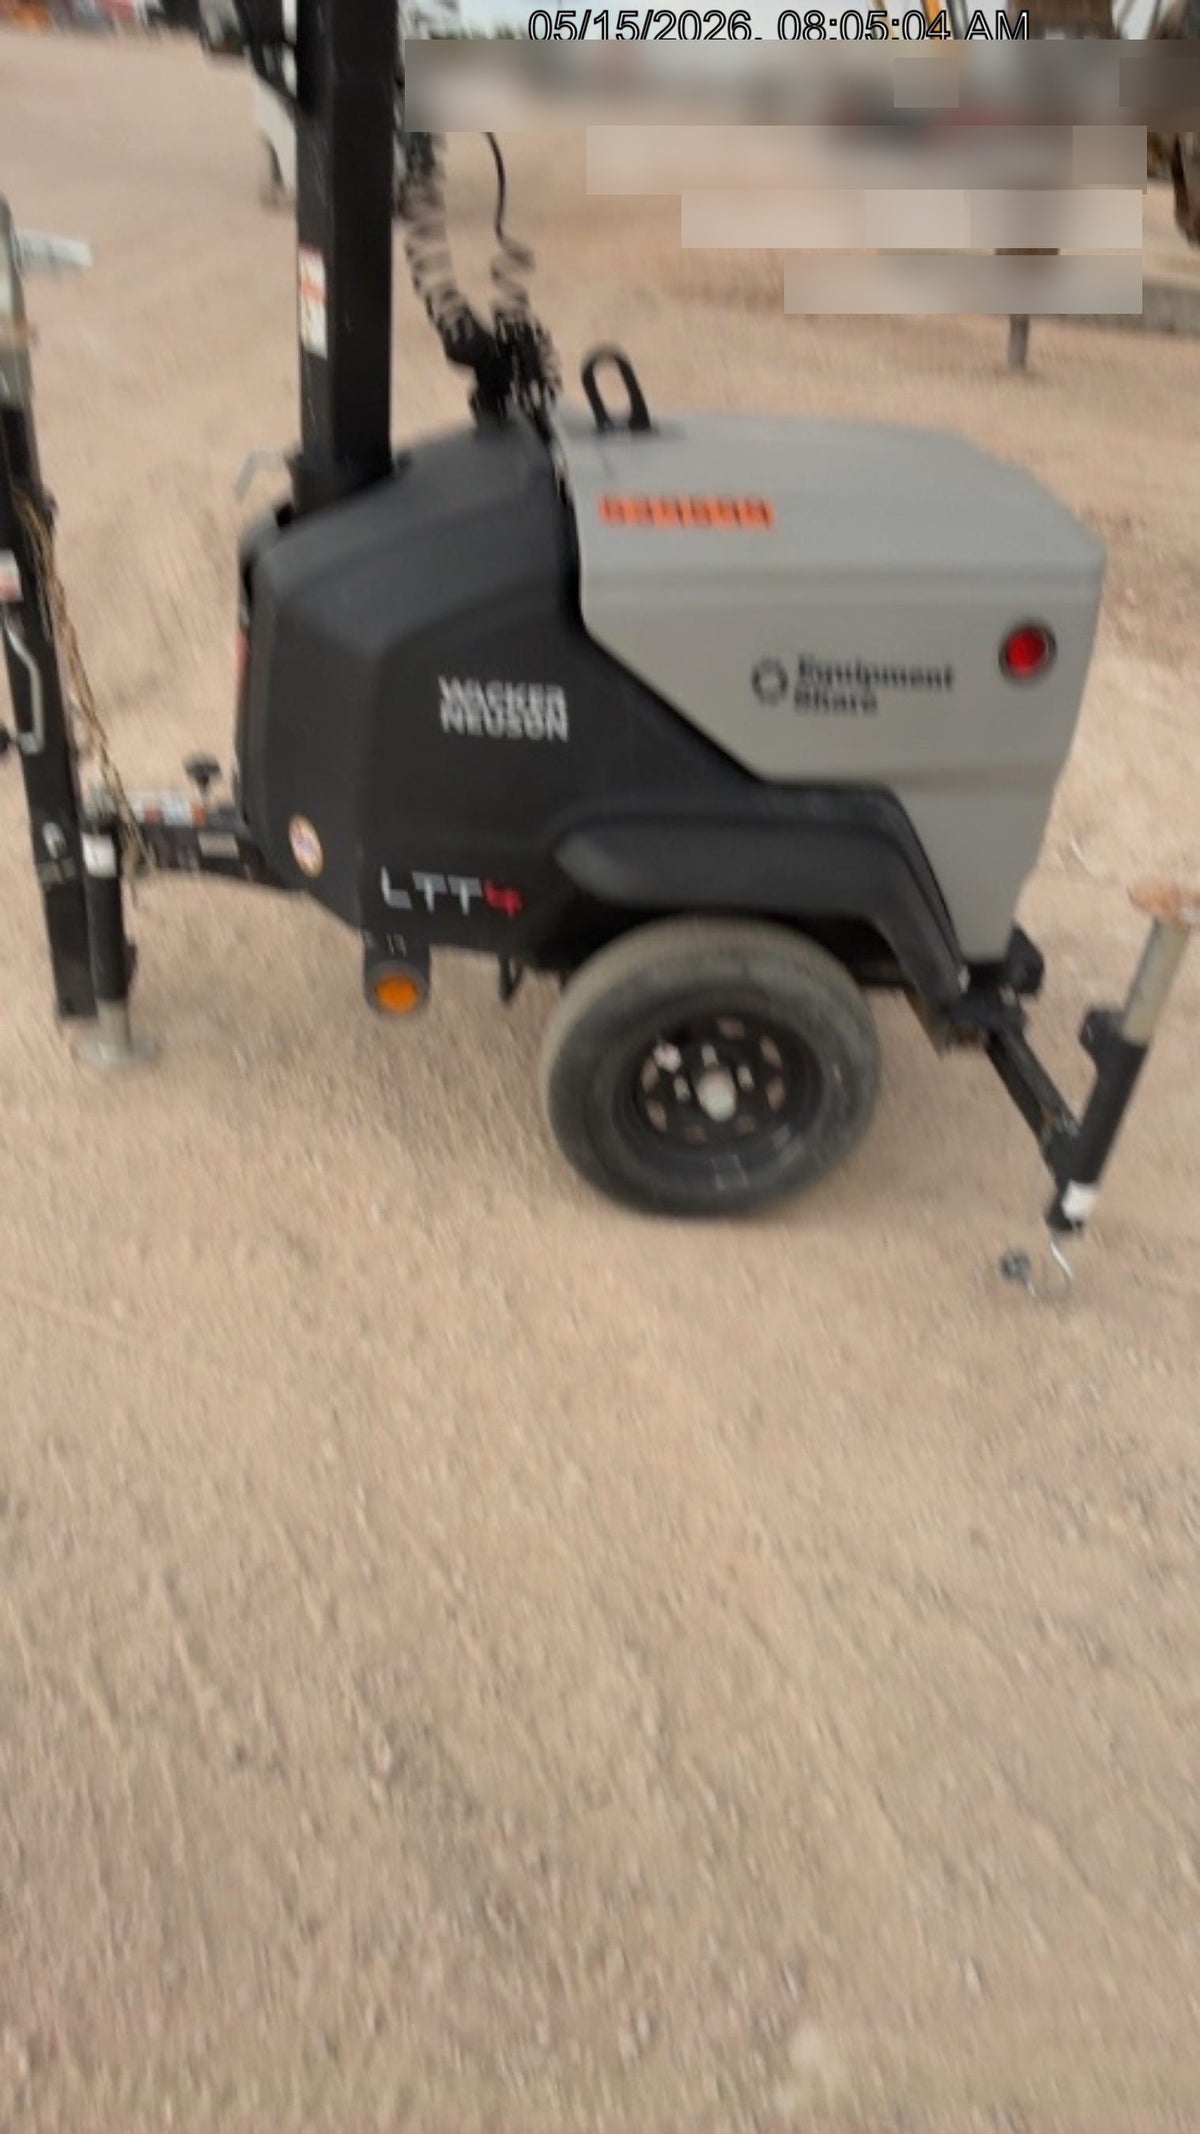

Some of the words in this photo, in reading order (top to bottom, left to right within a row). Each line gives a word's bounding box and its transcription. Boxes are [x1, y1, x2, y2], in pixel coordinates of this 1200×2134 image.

[438, 675, 566, 708] WACKER
[440, 702, 568, 742] NEUSON
[380, 865, 522, 918] LTT4
